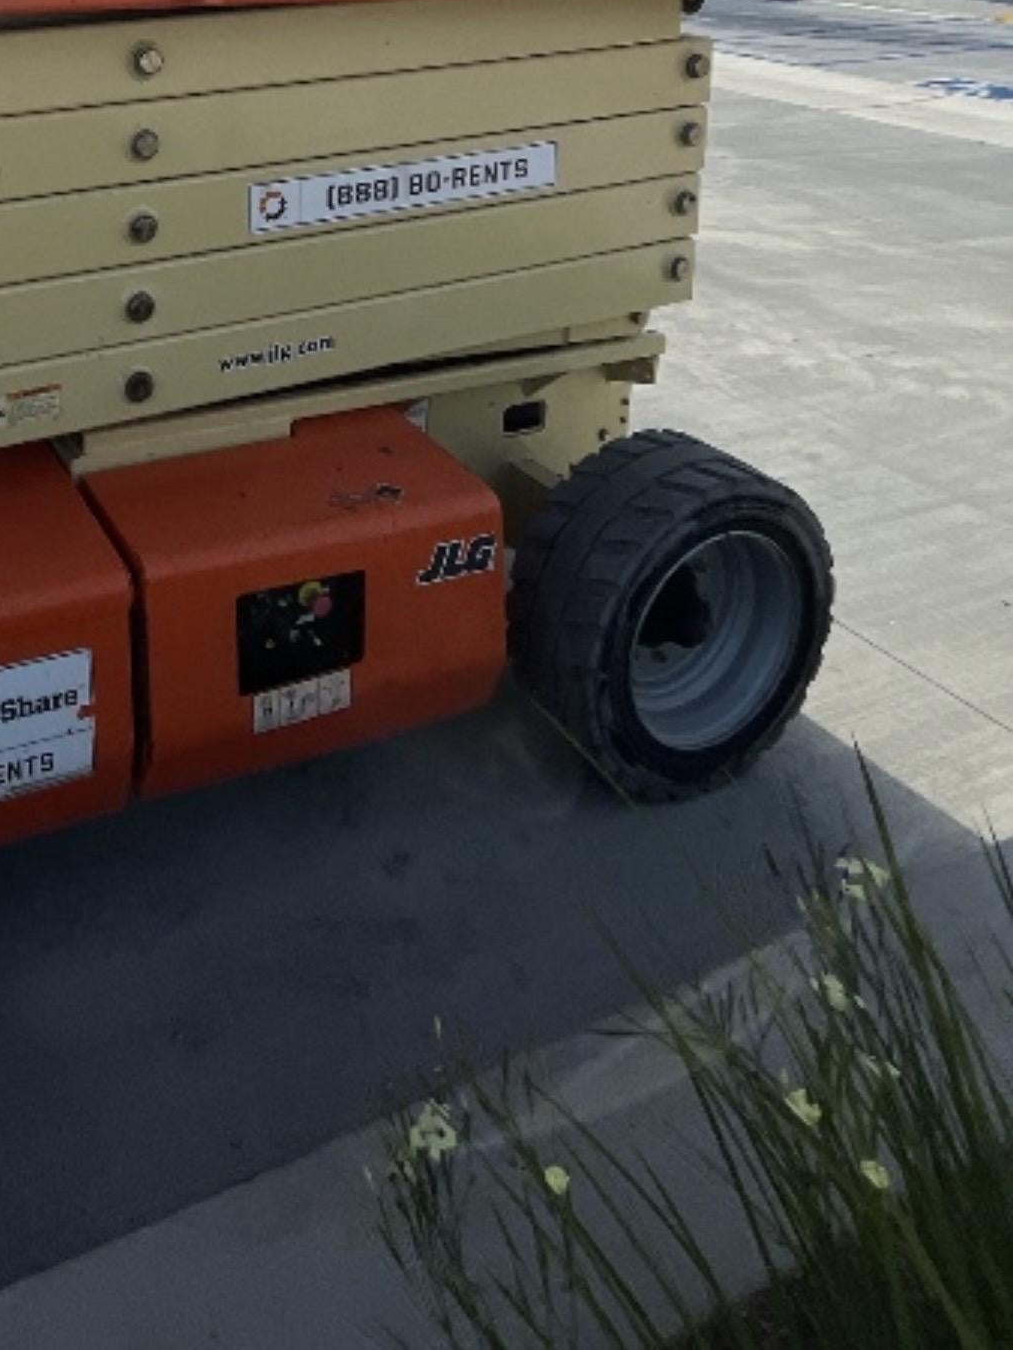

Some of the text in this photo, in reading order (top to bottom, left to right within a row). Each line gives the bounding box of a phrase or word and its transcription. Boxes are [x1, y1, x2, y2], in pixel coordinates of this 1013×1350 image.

[326, 158, 529, 211] (888) 80-RENTS
[416, 532, 497, 586] JLG
